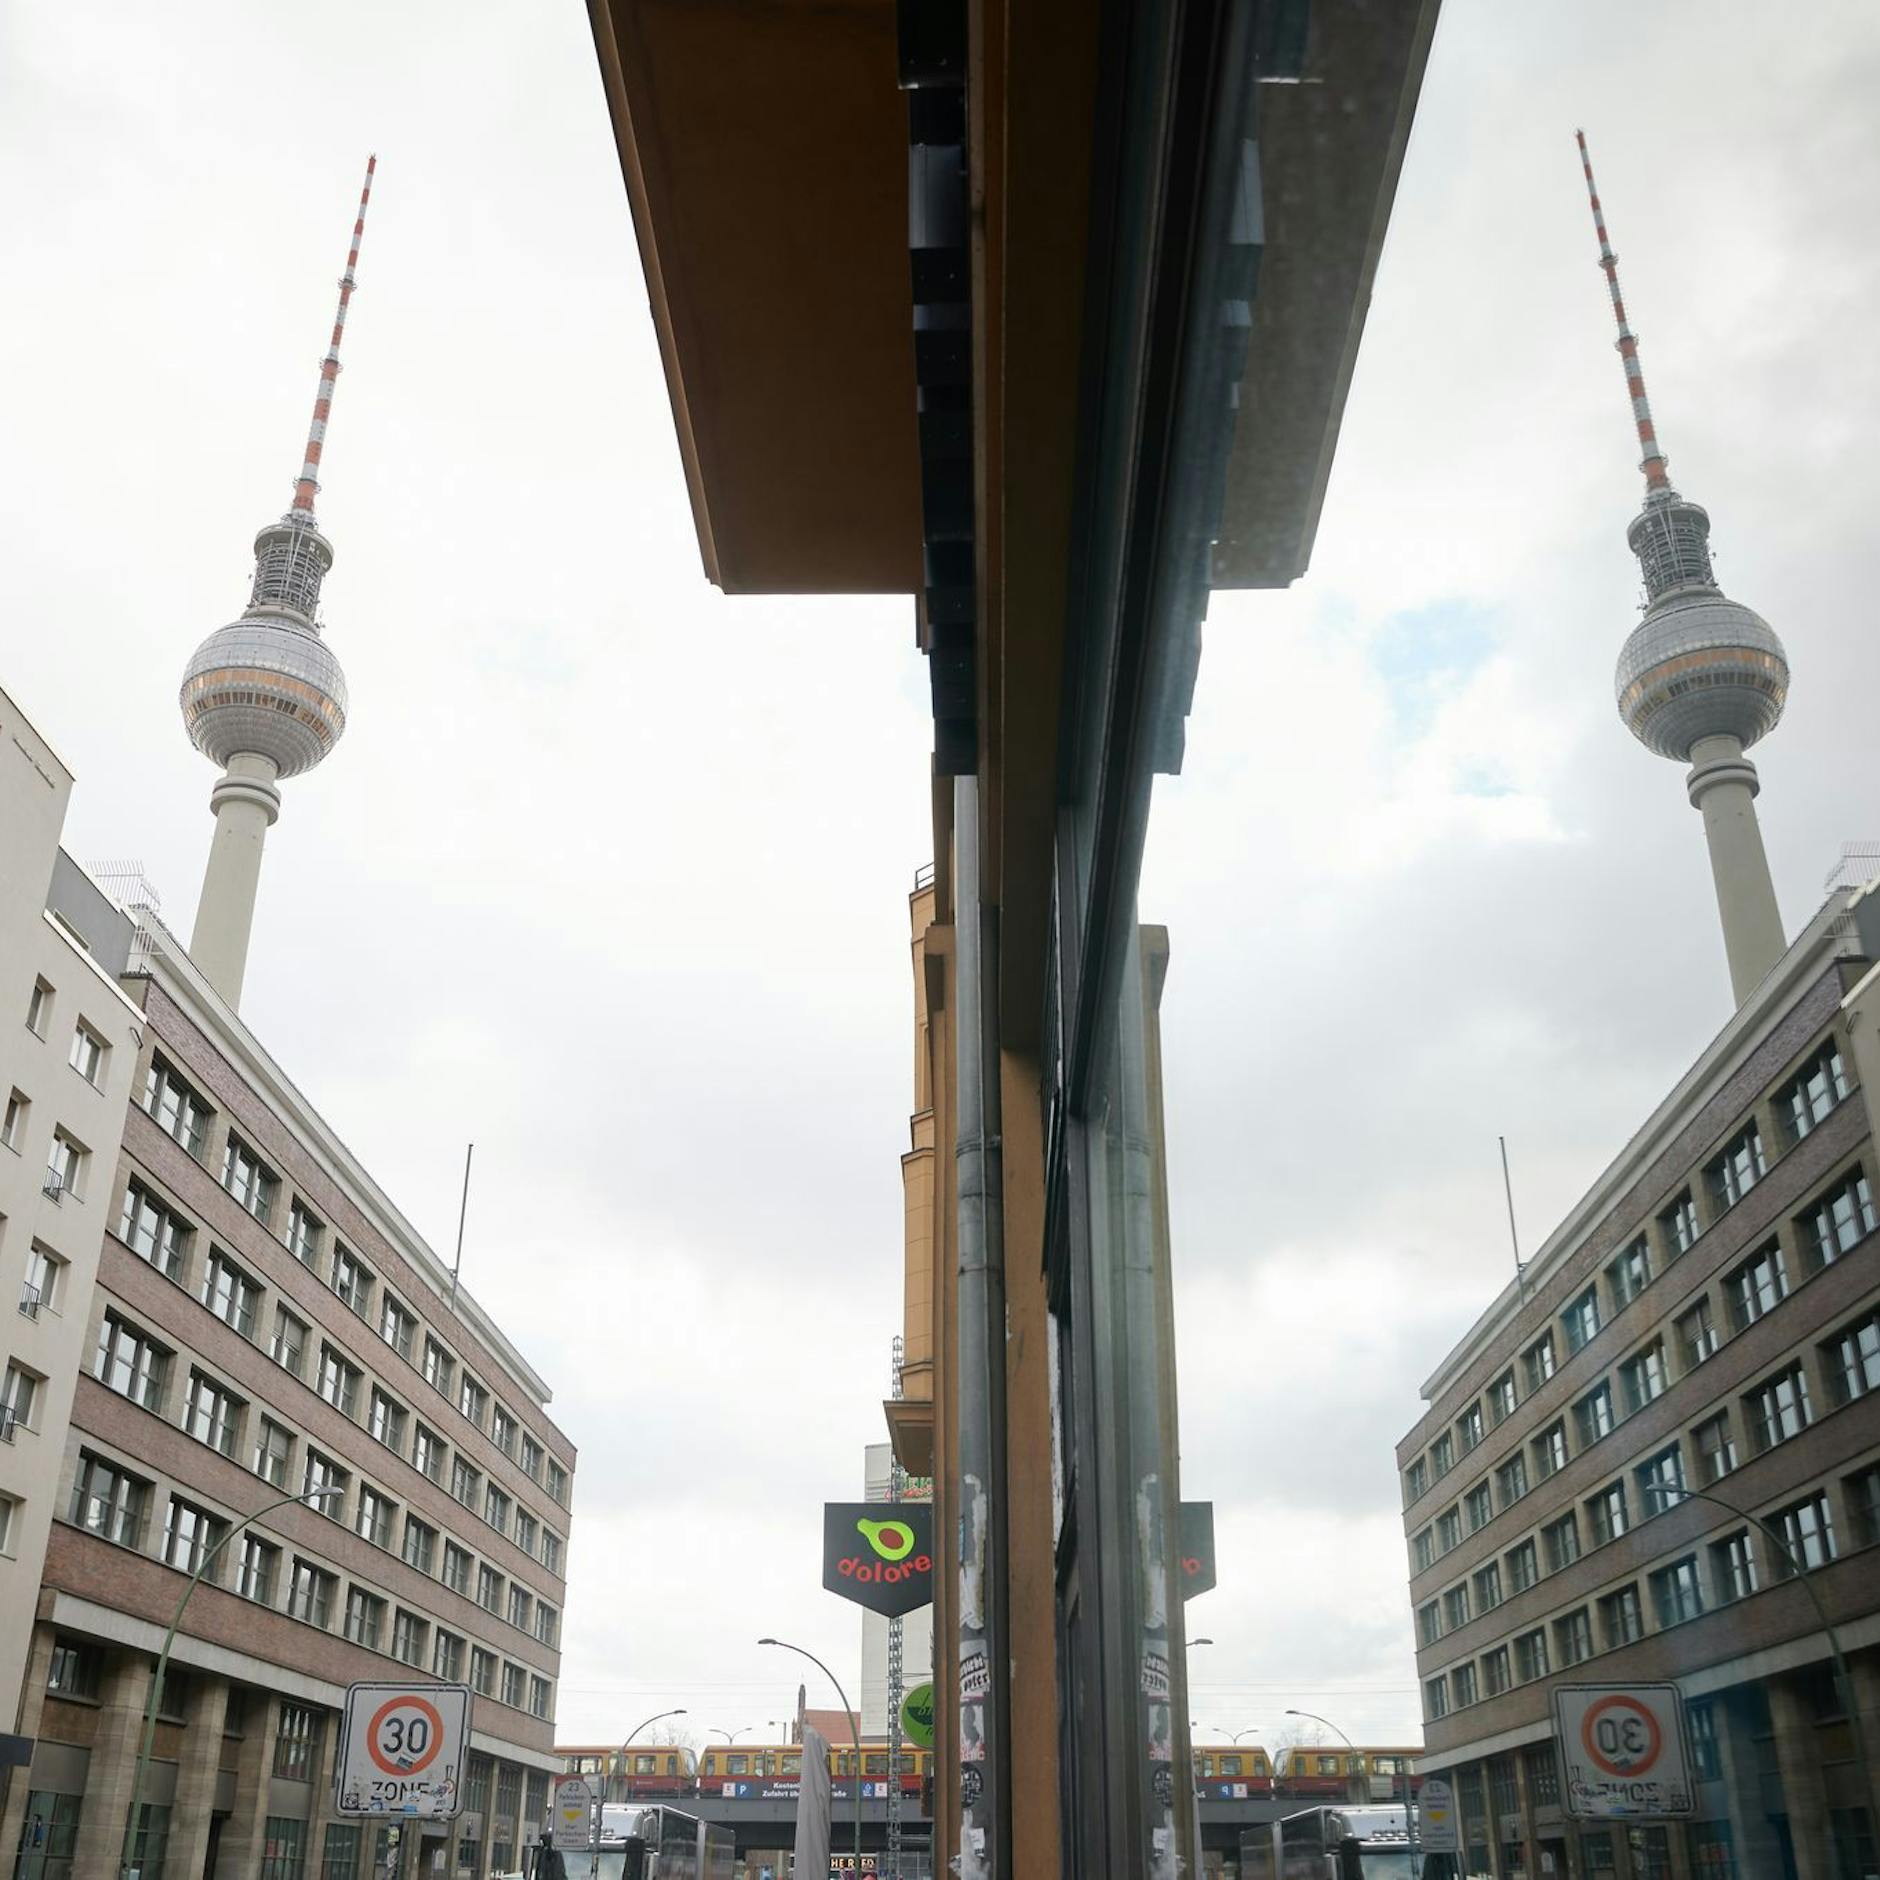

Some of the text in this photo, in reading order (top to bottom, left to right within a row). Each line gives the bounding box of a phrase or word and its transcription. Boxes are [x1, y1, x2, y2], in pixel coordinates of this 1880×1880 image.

[383, 1717, 428, 1754] 30
[568, 1782, 580, 1791] 23
[739, 1785, 747, 1794] P
